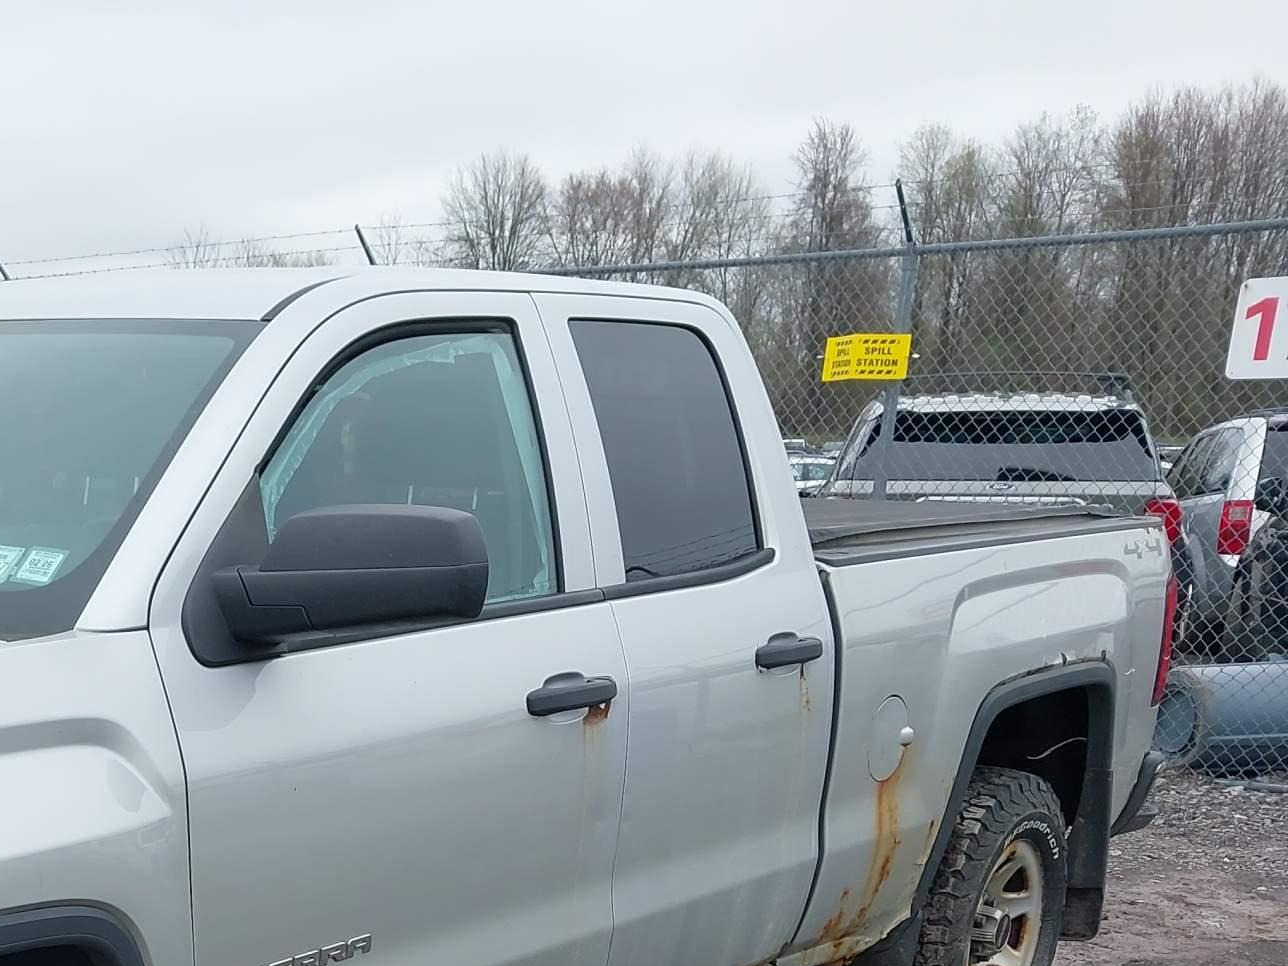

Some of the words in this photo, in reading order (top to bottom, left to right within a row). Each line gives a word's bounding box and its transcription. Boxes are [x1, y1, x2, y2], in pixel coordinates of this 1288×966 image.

[1245, 297, 1288, 361] 1
[864, 346, 893, 356] SPILL
[855, 358, 899, 367] STATION
